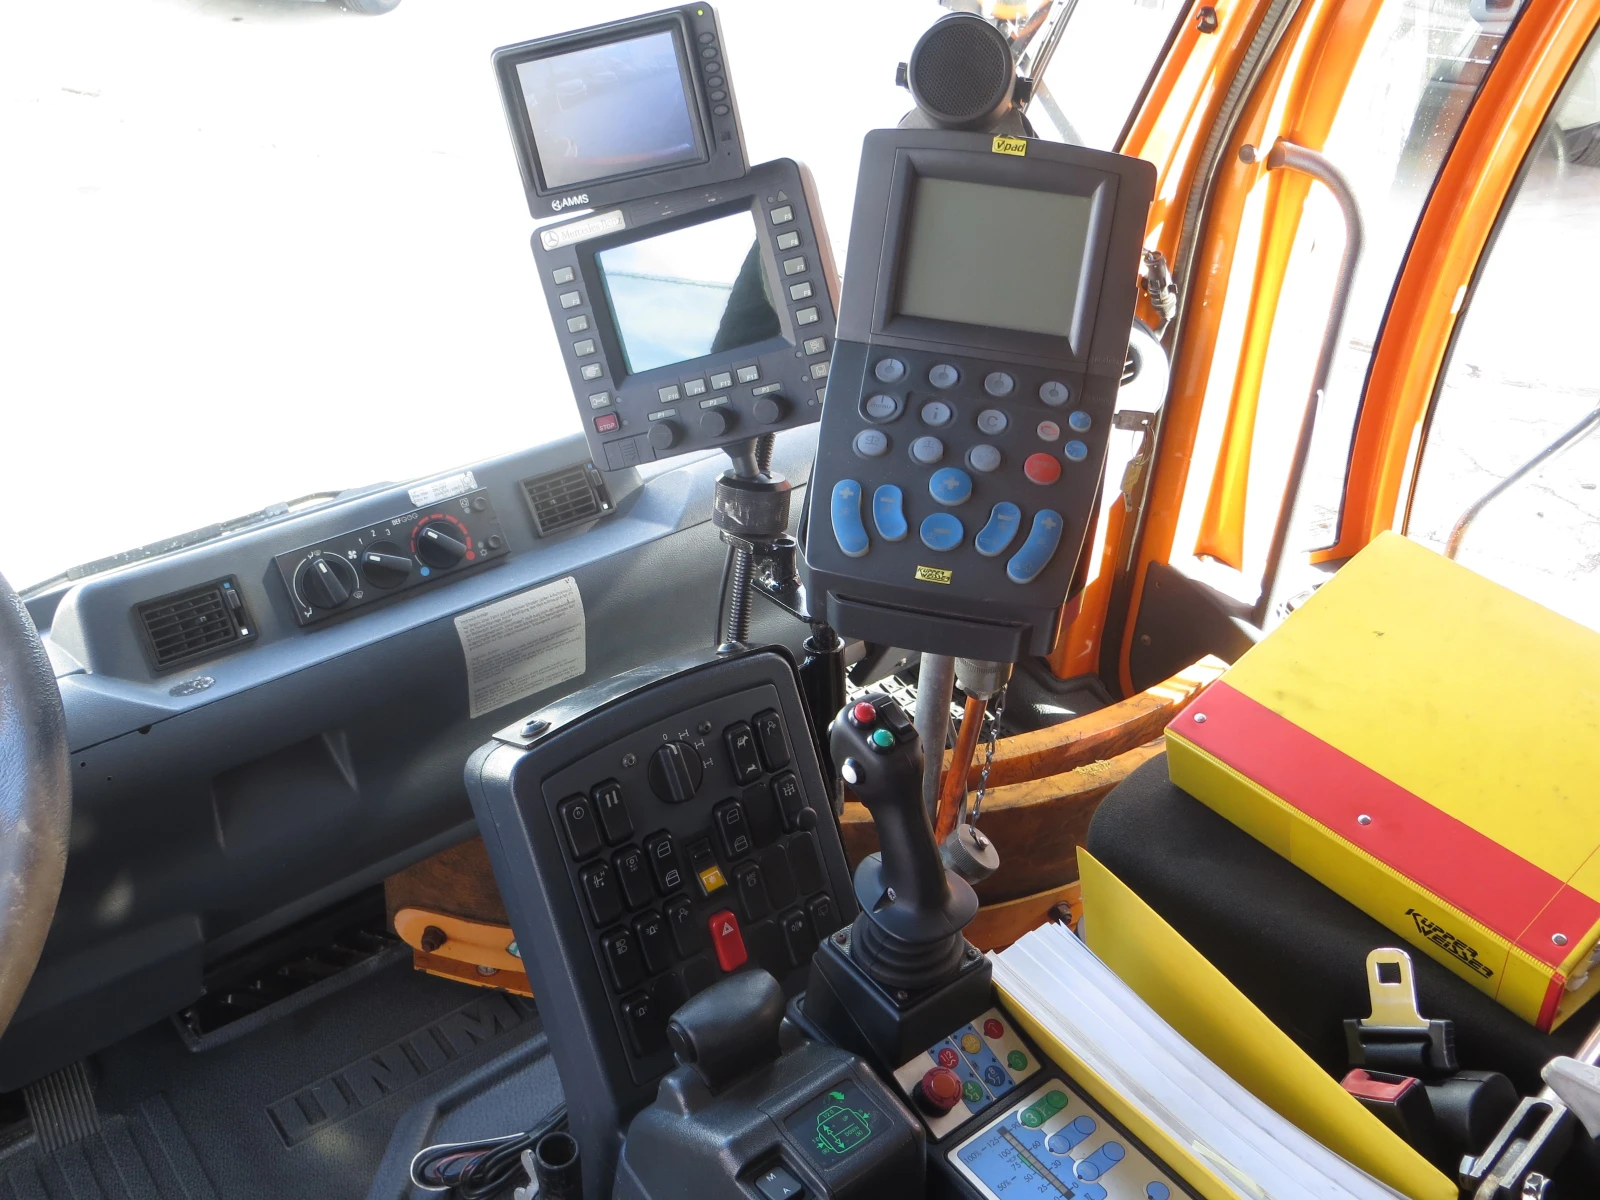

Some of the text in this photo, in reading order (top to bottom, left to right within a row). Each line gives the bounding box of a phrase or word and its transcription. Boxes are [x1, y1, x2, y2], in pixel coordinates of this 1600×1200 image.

[562, 194, 589, 207] AMMS
[561, 217, 624, 241] Mercedes-Benz
[987, 415, 998, 427] C
[599, 422, 615, 431] STOP
[370, 529, 377, 537] 2
[385, 528, 391, 536] 3
[265, 992, 541, 1149] UNIM
[986, 1136, 1000, 1149] 125
[1032, 1140, 1041, 1150] 60
[998, 1147, 1012, 1160] 100
[1010, 1161, 1022, 1171] 75
[1051, 1159, 1062, 1169] 30
[765, 1172, 777, 1182] M
[1023, 1173, 1034, 1183] 50
[782, 1187, 791, 1195] A
[1037, 1183, 1048, 1194] 25
